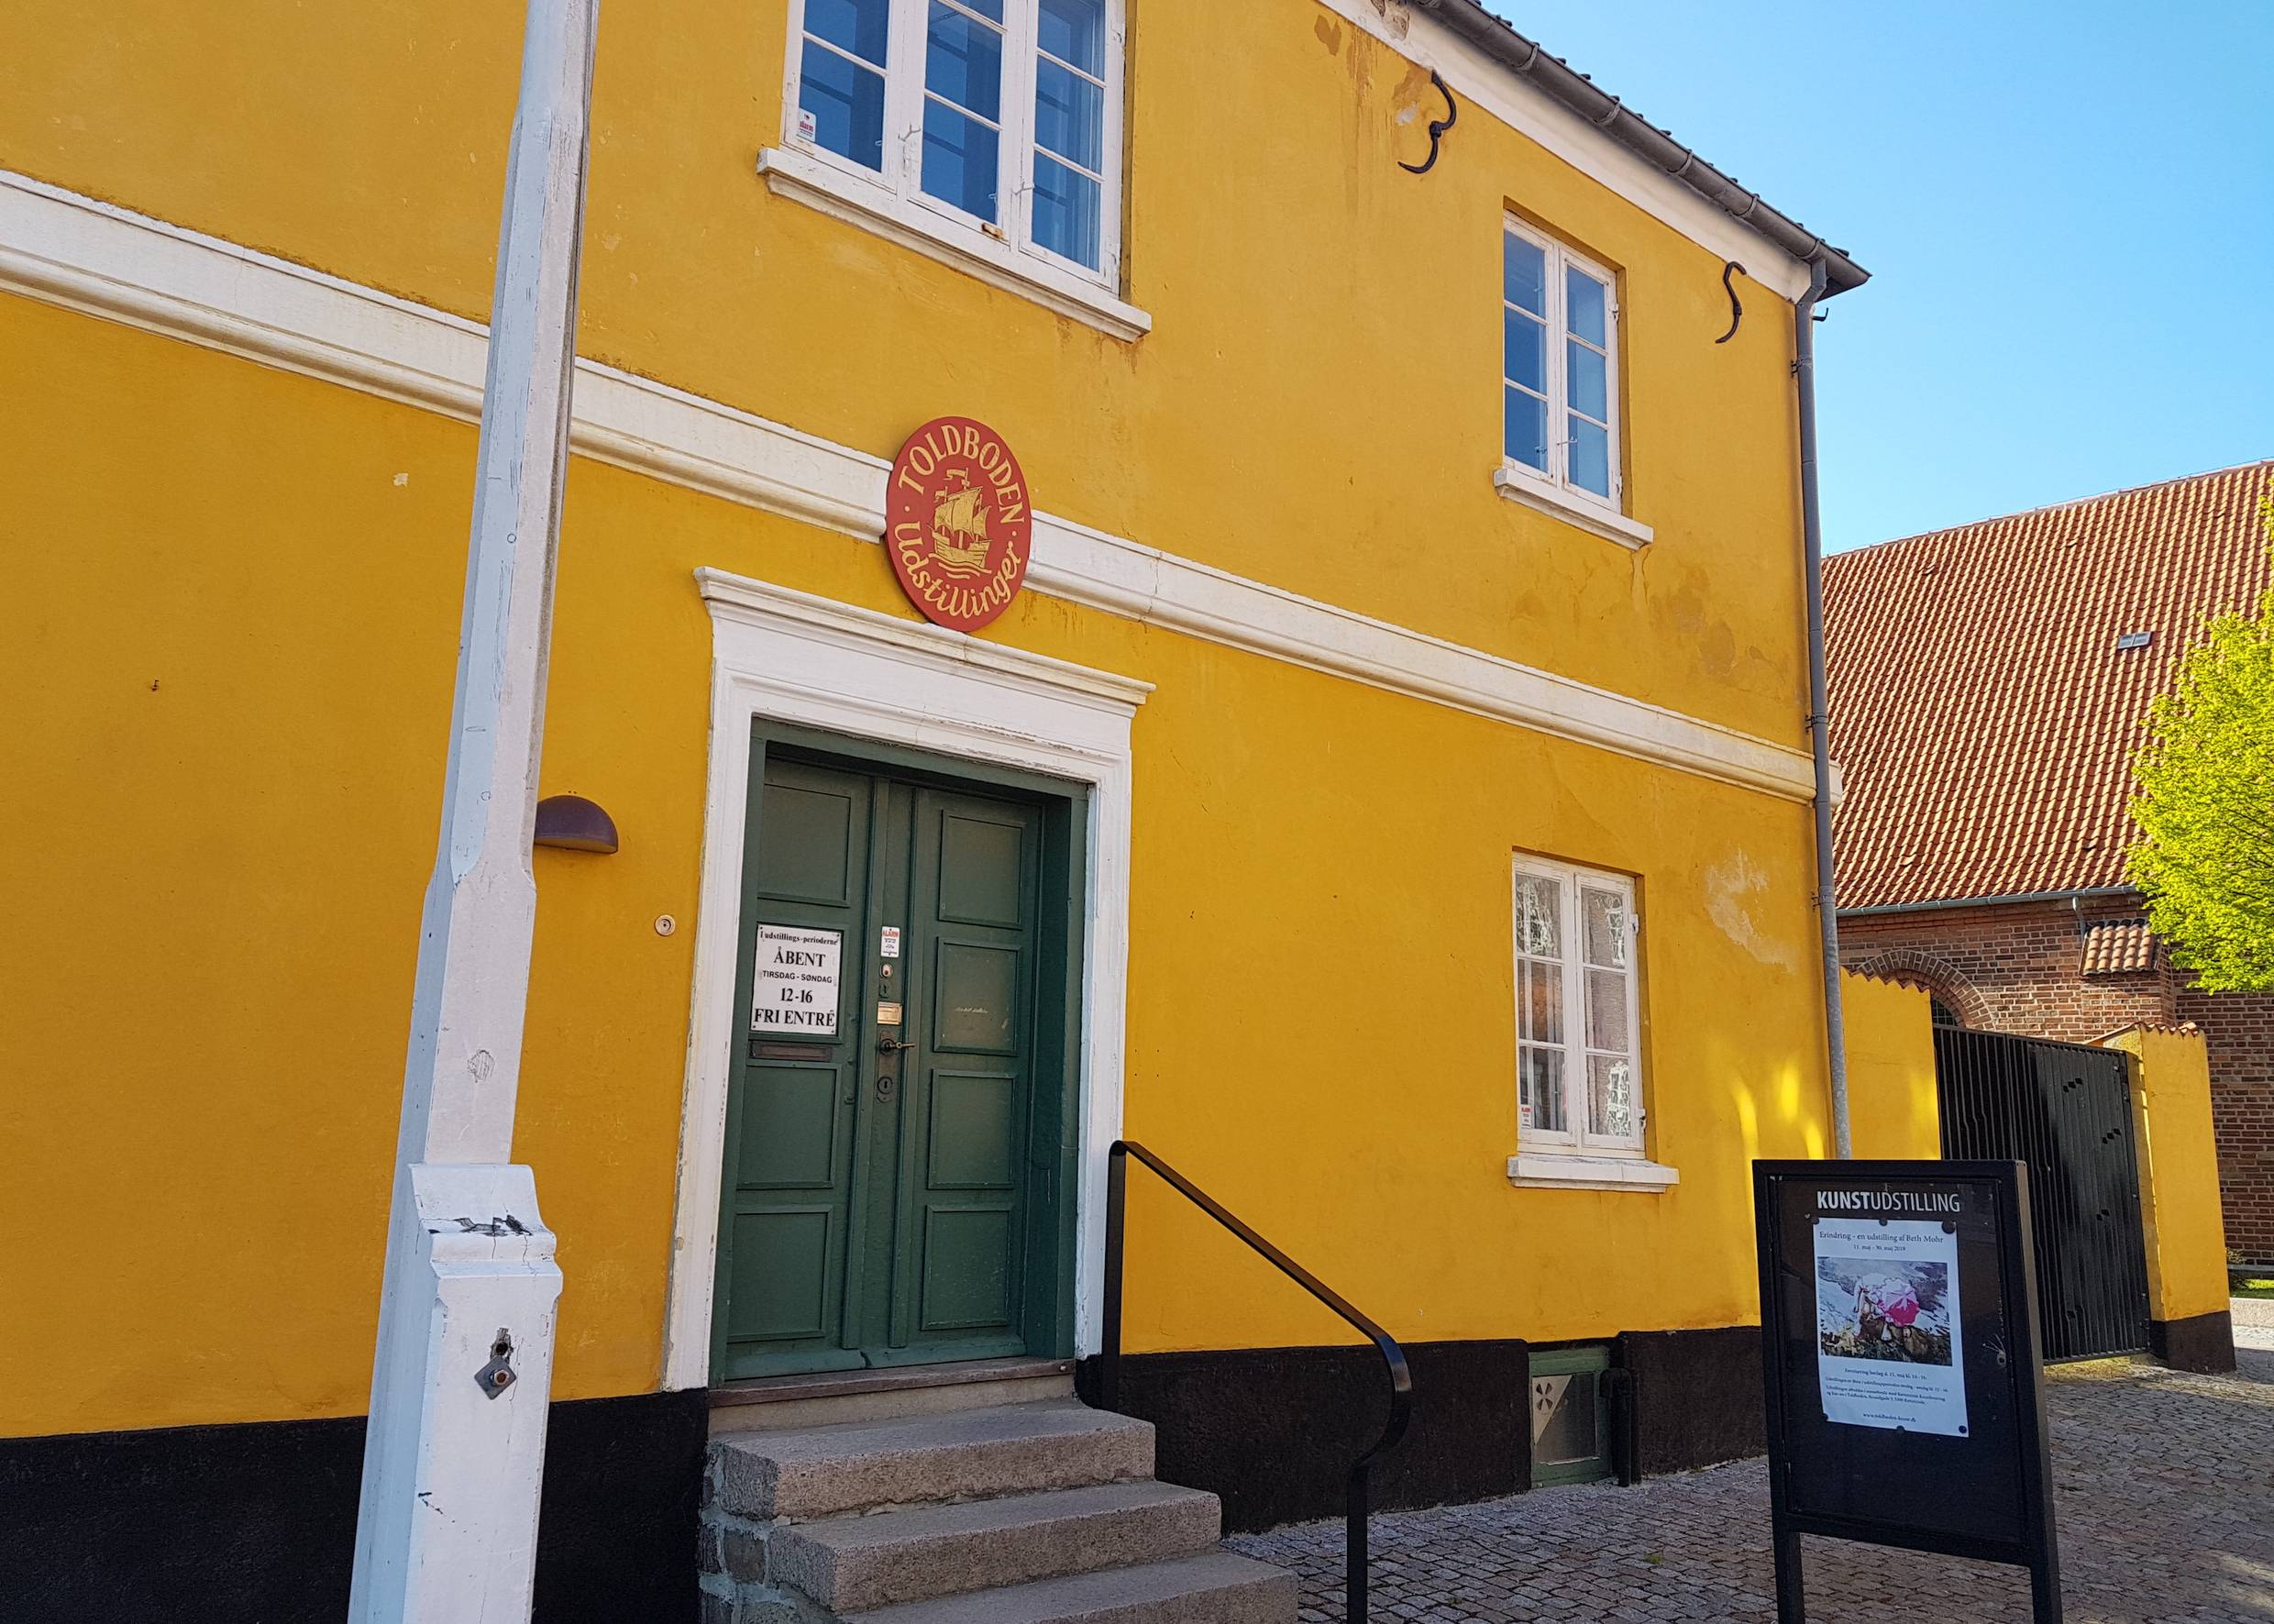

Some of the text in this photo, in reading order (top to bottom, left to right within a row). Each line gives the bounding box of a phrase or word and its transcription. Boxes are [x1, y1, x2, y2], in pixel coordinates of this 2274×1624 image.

[898, 424, 1025, 525] TOLDBODEN
[894, 520, 1021, 619] Udstillinger
[773, 945, 826, 967] ÅBENT
[762, 970, 796, 980] TIRSDAG
[800, 974, 833, 984] SØNDAG
[754, 1009, 835, 1027] FRI ENTRÉ
[1817, 1191, 1960, 1212] KUNSTUDSTILLING
[1819, 1232, 1852, 1241] Erindring
[1867, 1233, 1898, 1243] udstilling
[1899, 1233, 1905, 1242] af
[1905, 1234, 1922, 1243] Beth
[1924, 1234, 1944, 1243] Mohr
